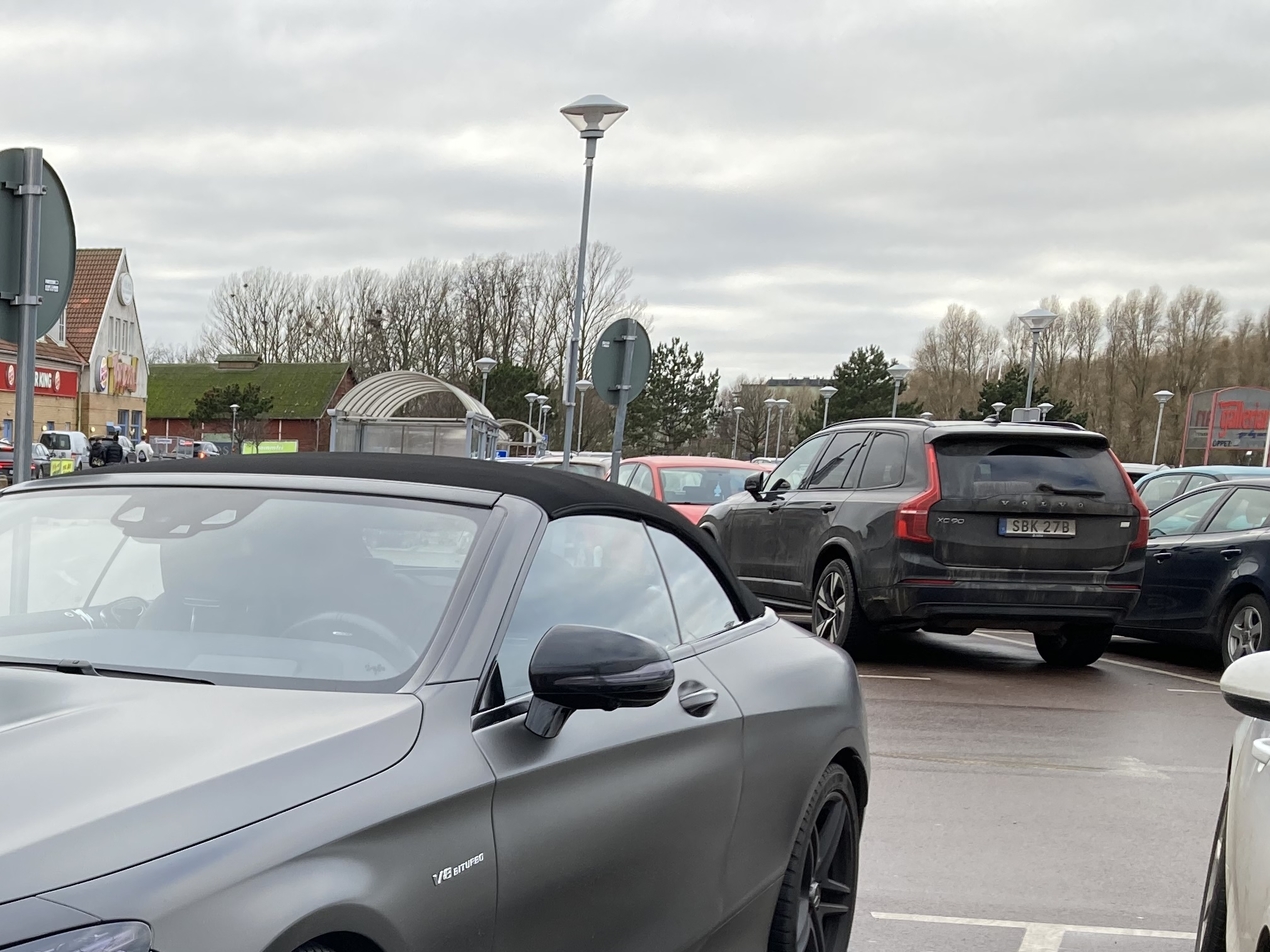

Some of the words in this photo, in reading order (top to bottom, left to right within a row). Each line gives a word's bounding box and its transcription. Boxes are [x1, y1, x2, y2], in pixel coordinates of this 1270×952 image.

[1001, 500, 1084, 508] VOLVO
[1012, 519, 1038, 532] SBK
[1043, 520, 1070, 533] 27B
[432, 867, 452, 886] V8
